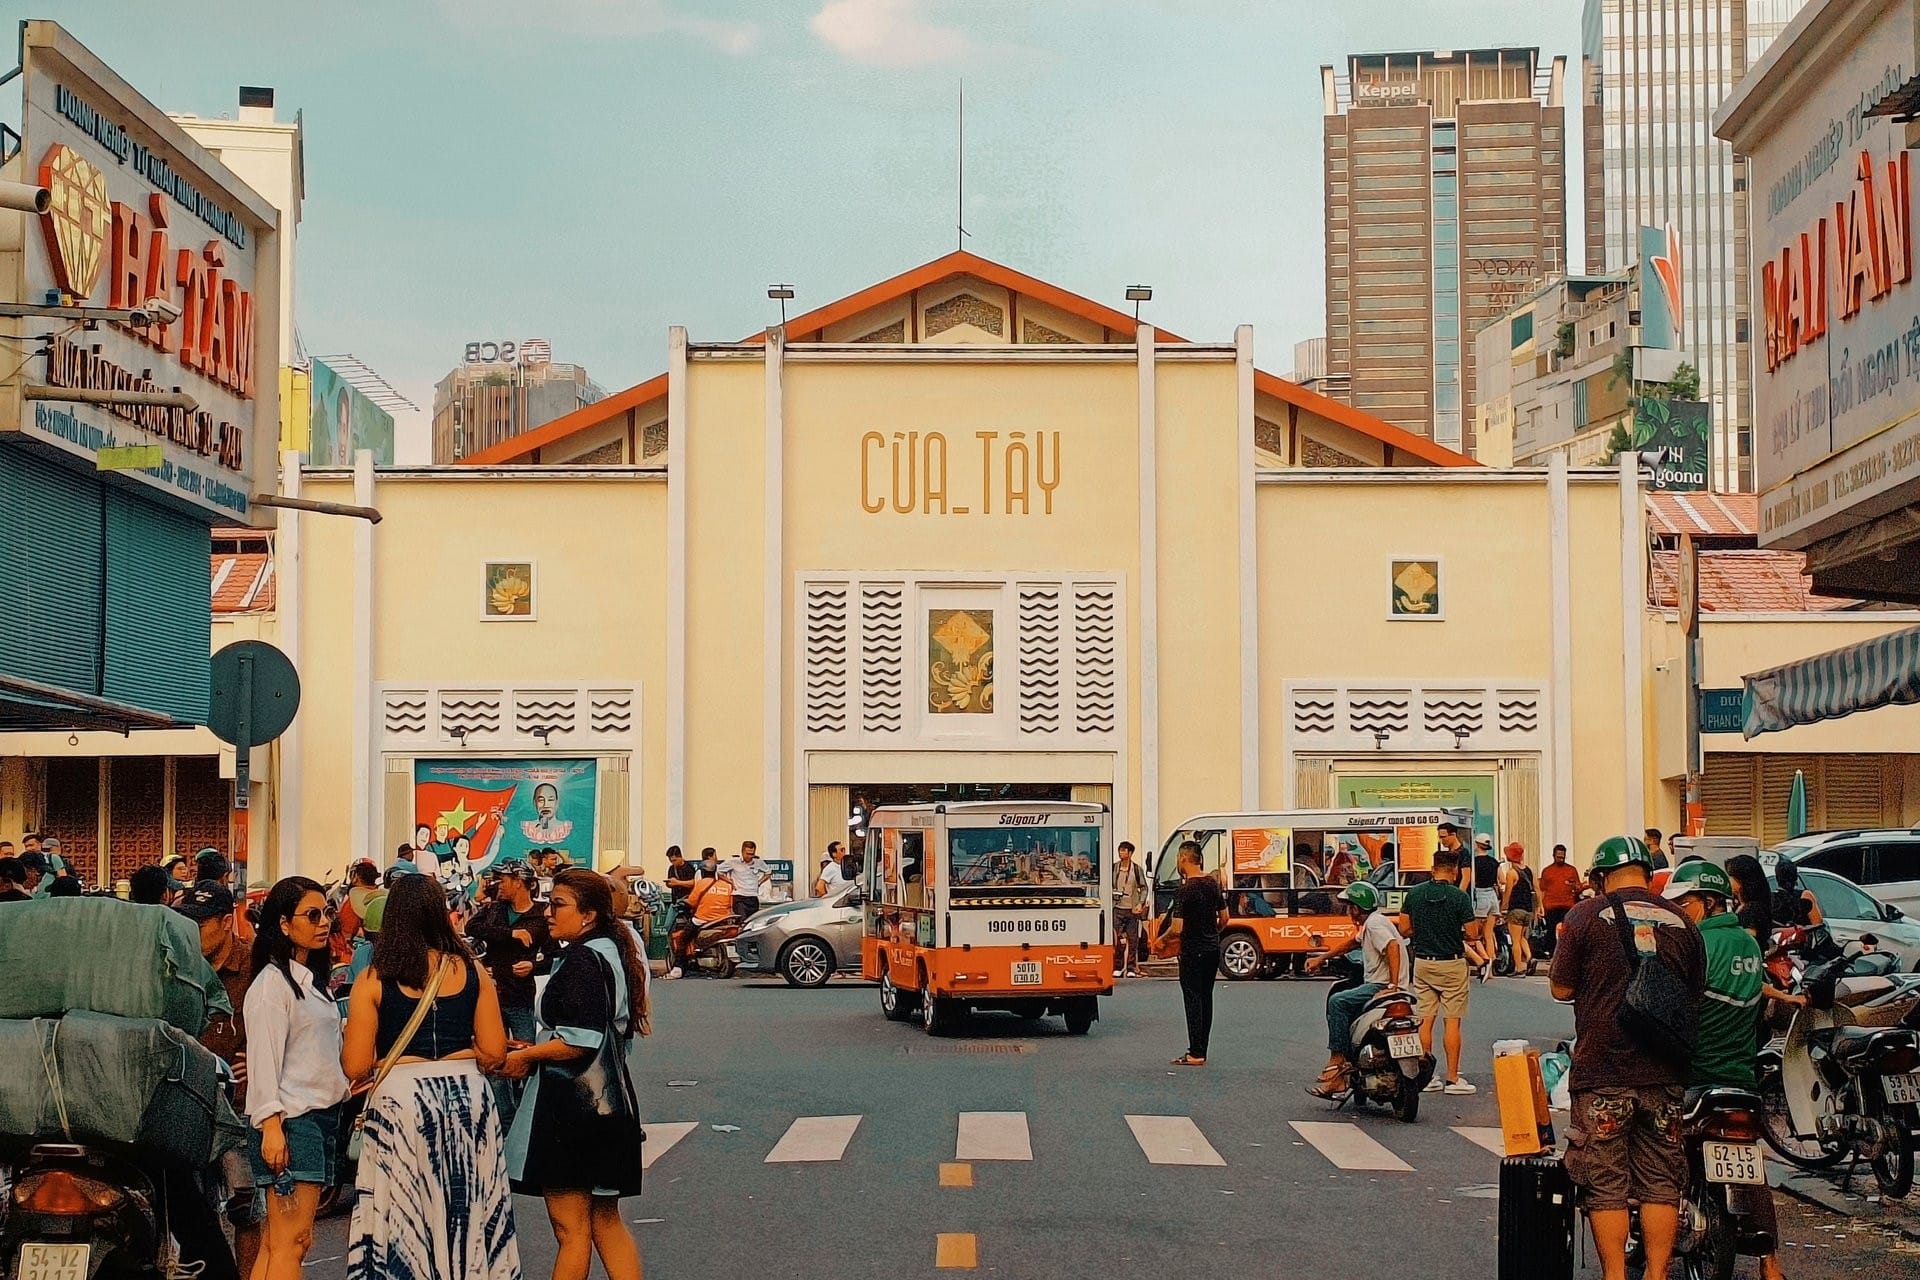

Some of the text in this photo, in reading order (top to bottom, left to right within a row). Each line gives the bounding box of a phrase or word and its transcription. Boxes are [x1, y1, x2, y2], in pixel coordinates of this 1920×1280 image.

[1358, 82, 1417, 98] Keppel
[1762, 149, 1912, 374] MAI VÂN
[176, 239, 256, 401] TÂM
[1700, 873, 1724, 885] Grab
[988, 920, 1015, 932] 1900
[1051, 919, 1067, 932] 69
[1269, 924, 1314, 938] MEX
[1046, 955, 1074, 965] MEX
[31, 1248, 79, 1266] 54-V2
